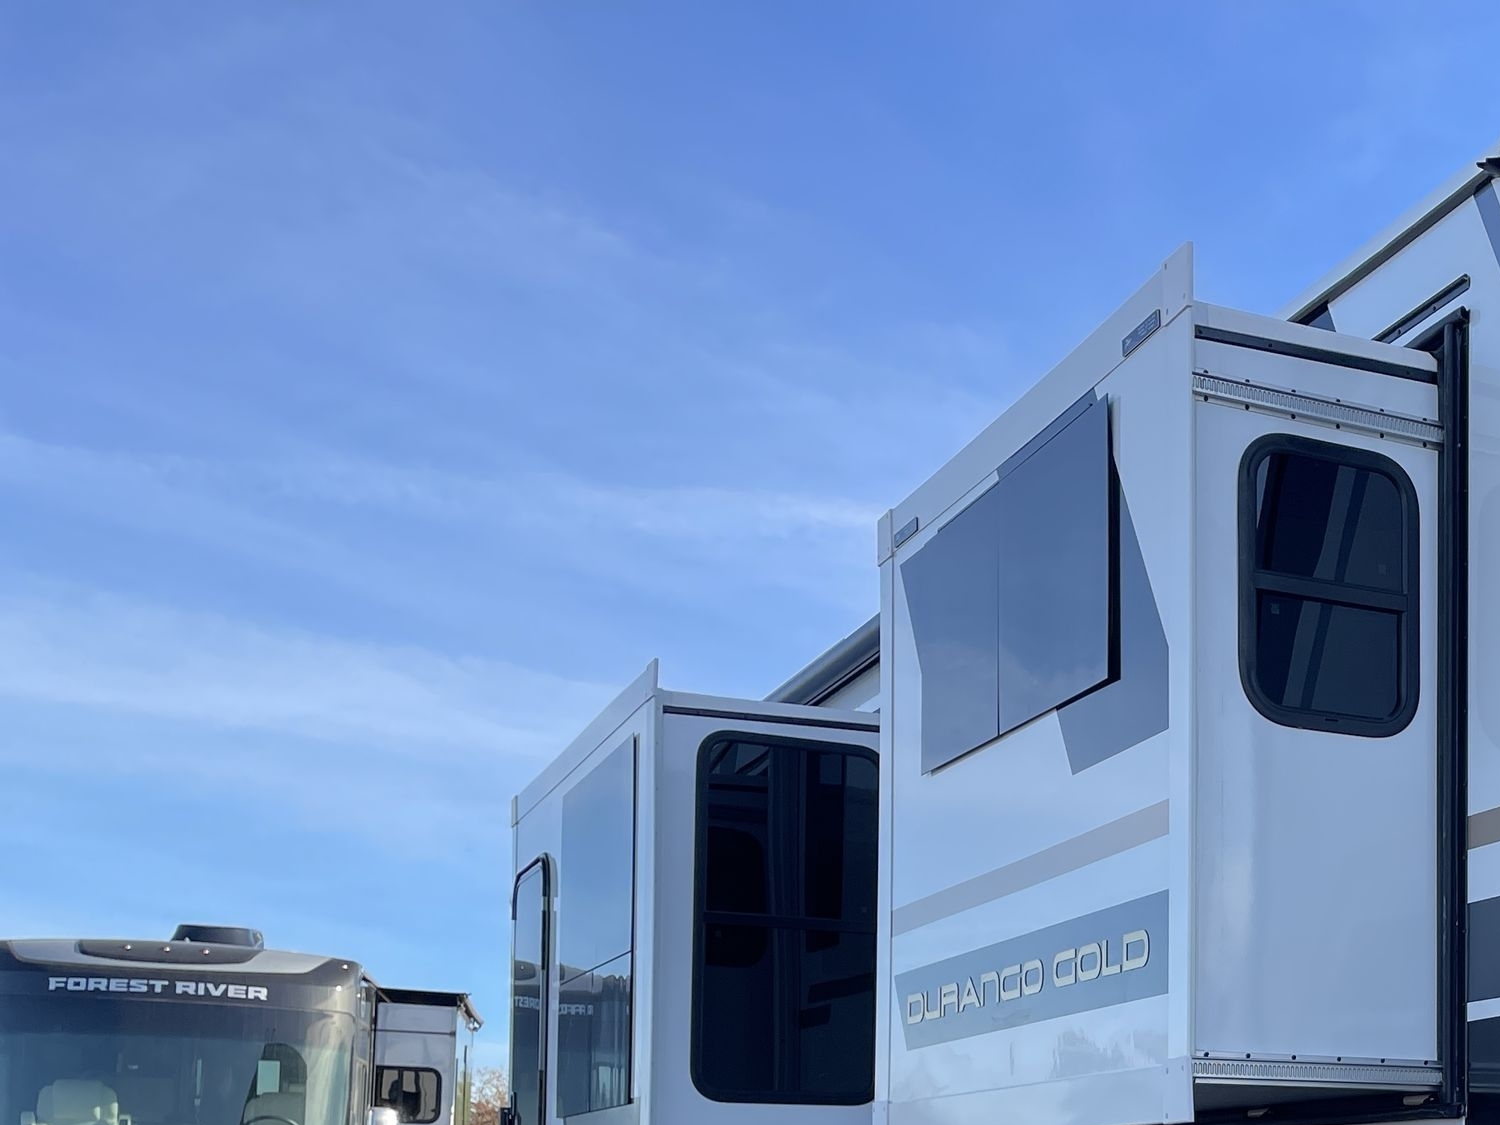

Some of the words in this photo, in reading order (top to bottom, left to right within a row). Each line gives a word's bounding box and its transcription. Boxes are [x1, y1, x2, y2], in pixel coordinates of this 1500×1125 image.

[48, 976, 169, 994] FOREST
[175, 980, 268, 1001] RIVER
[906, 958, 1045, 1025] DURANGO
[1053, 929, 1151, 988] GOLD
